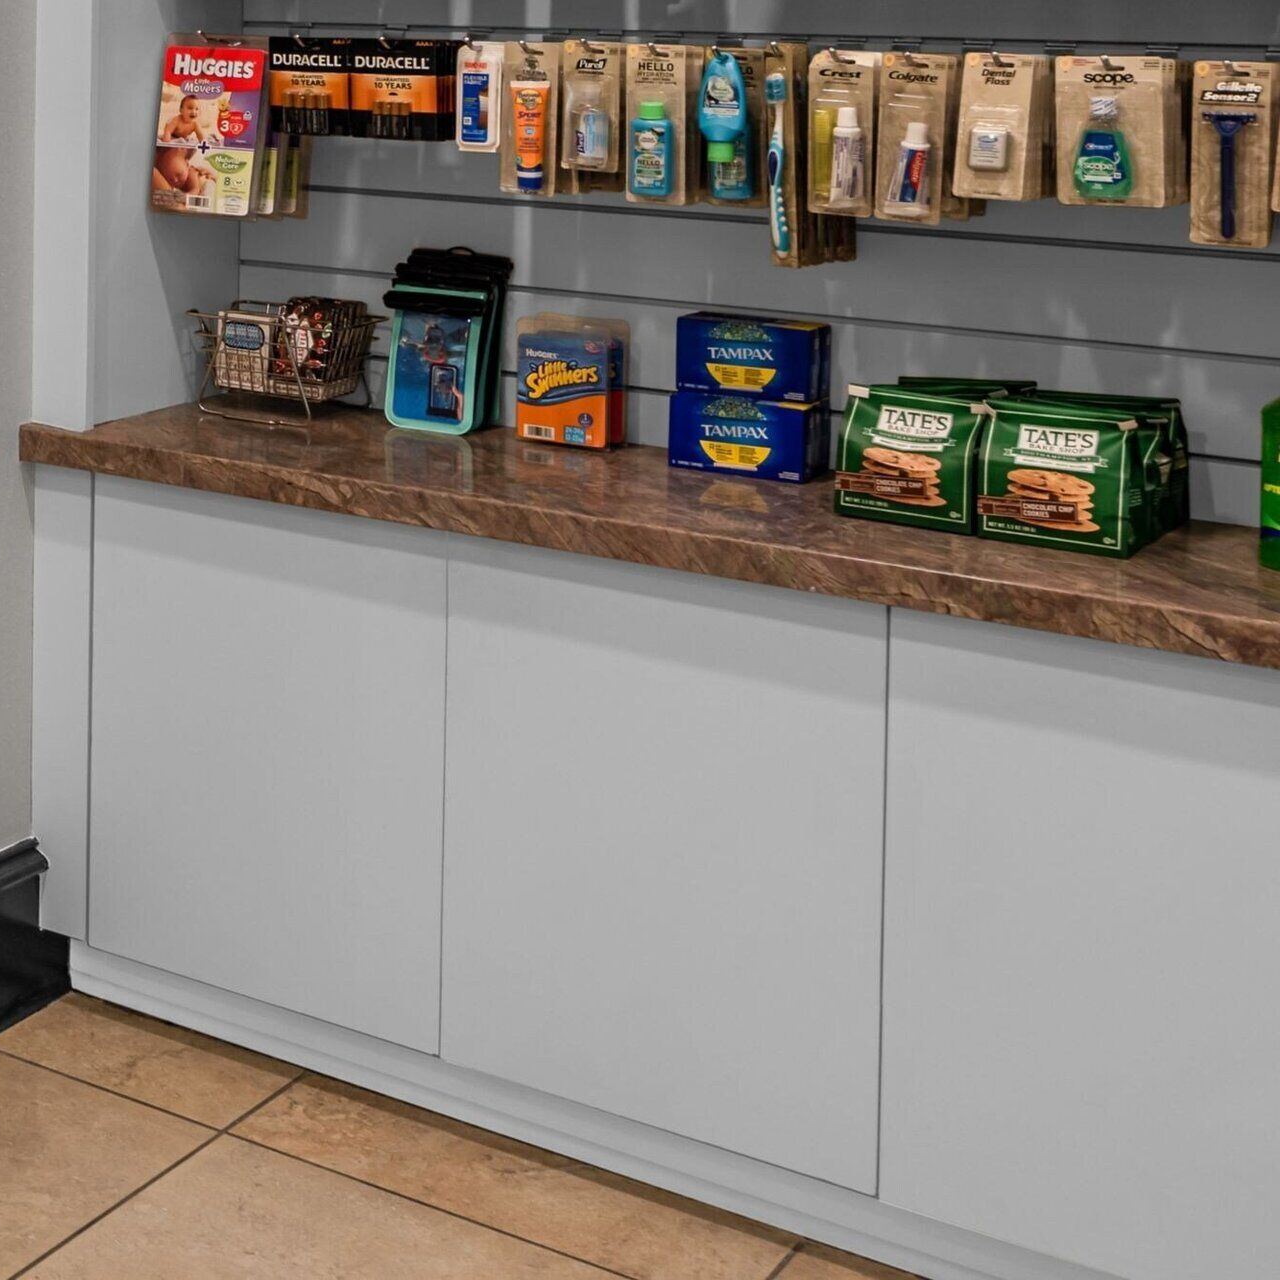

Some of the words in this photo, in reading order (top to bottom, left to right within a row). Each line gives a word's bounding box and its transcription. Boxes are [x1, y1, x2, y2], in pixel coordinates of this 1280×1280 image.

[174, 53, 254, 79] HUGGIES
[273, 53, 341, 67] DURACELL
[355, 55, 429, 70] DURACELL
[578, 58, 607, 71] Purell
[638, 62, 674, 72] HELLO
[819, 68, 863, 79] Crest
[888, 70, 939, 84] Colgate
[981, 68, 1016, 81] Dental
[1084, 72, 1134, 85] scope
[384, 82, 412, 90] YEARS
[985, 77, 1011, 86] Floss
[1216, 82, 1263, 93] Gillette
[184, 83, 222, 95] Movers
[220, 119, 229, 131] 3
[525, 348, 559, 359] HUGGIES
[706, 346, 774, 362] TAMPAX
[526, 366, 599, 399] Swimmers
[885, 409, 948, 431] TATE'S
[700, 424, 769, 441] TAMPAX
[1025, 429, 1093, 449] TATE'S
[1029, 443, 1054, 451] BAKE
[1023, 510, 1050, 518] COOKIES
